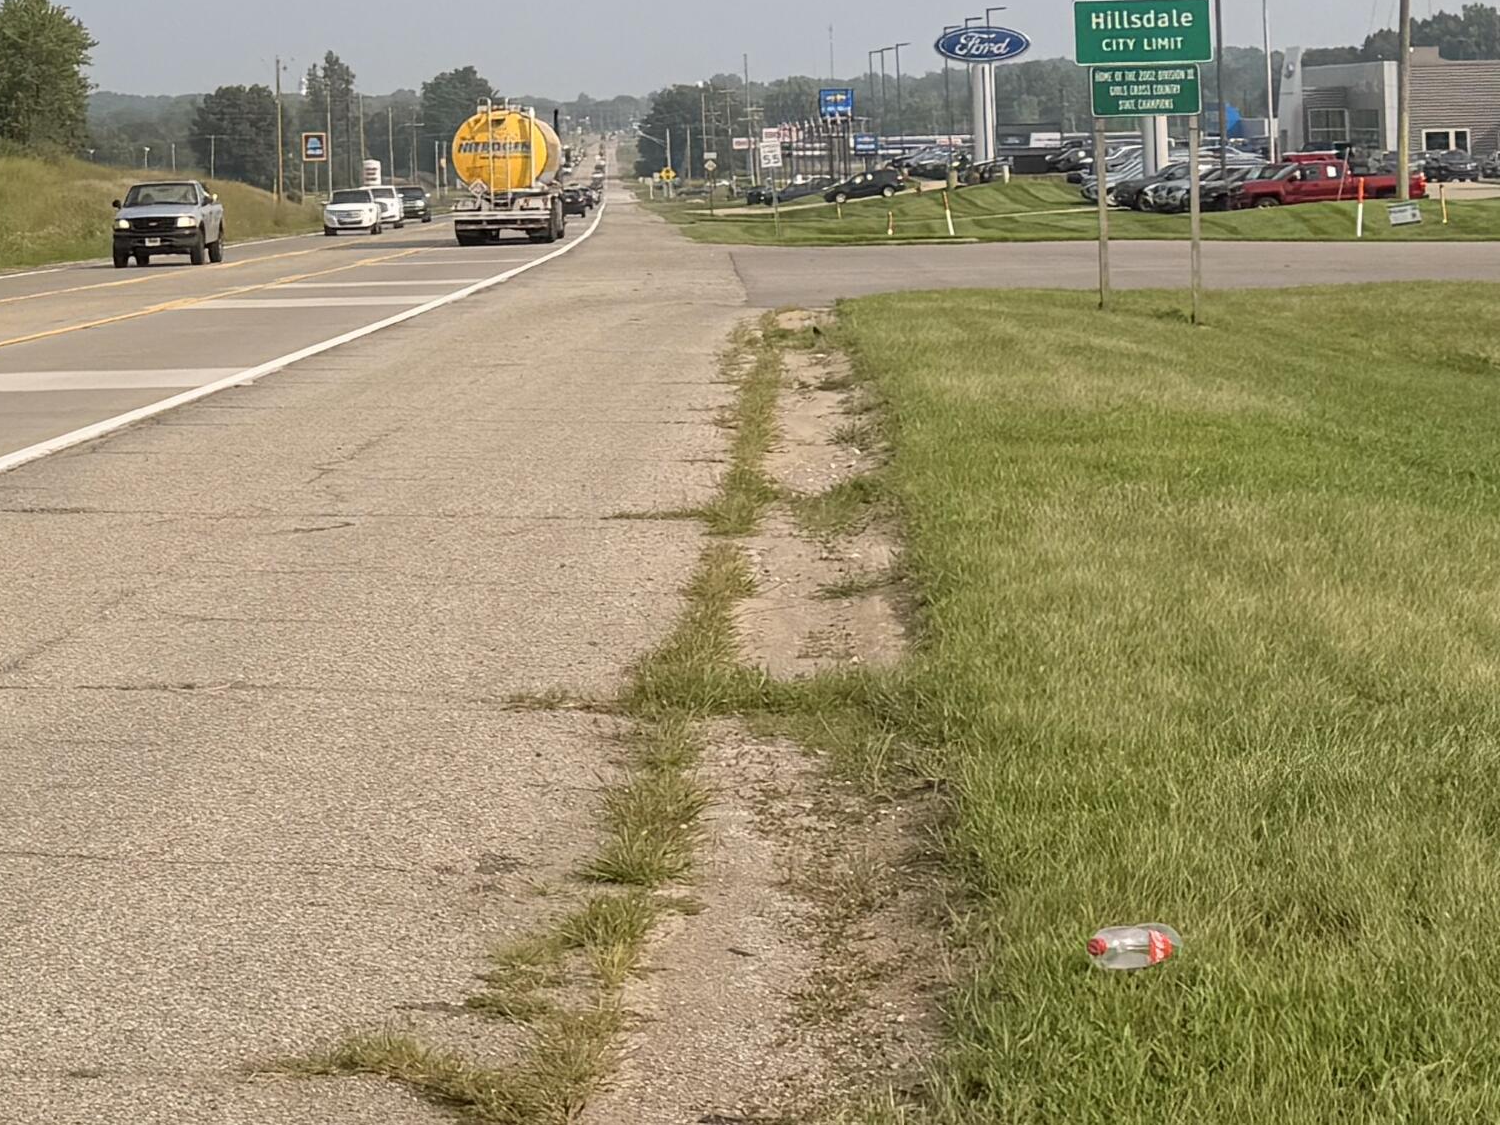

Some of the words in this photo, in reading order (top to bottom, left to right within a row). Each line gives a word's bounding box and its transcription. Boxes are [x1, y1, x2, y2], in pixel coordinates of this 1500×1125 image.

[1091, 9, 1193, 29] Hillsdale
[955, 33, 1011, 55] Ford
[1102, 38, 1136, 51] CITY
[1143, 37, 1184, 50] LIMIT
[763, 154, 780, 165] 55
